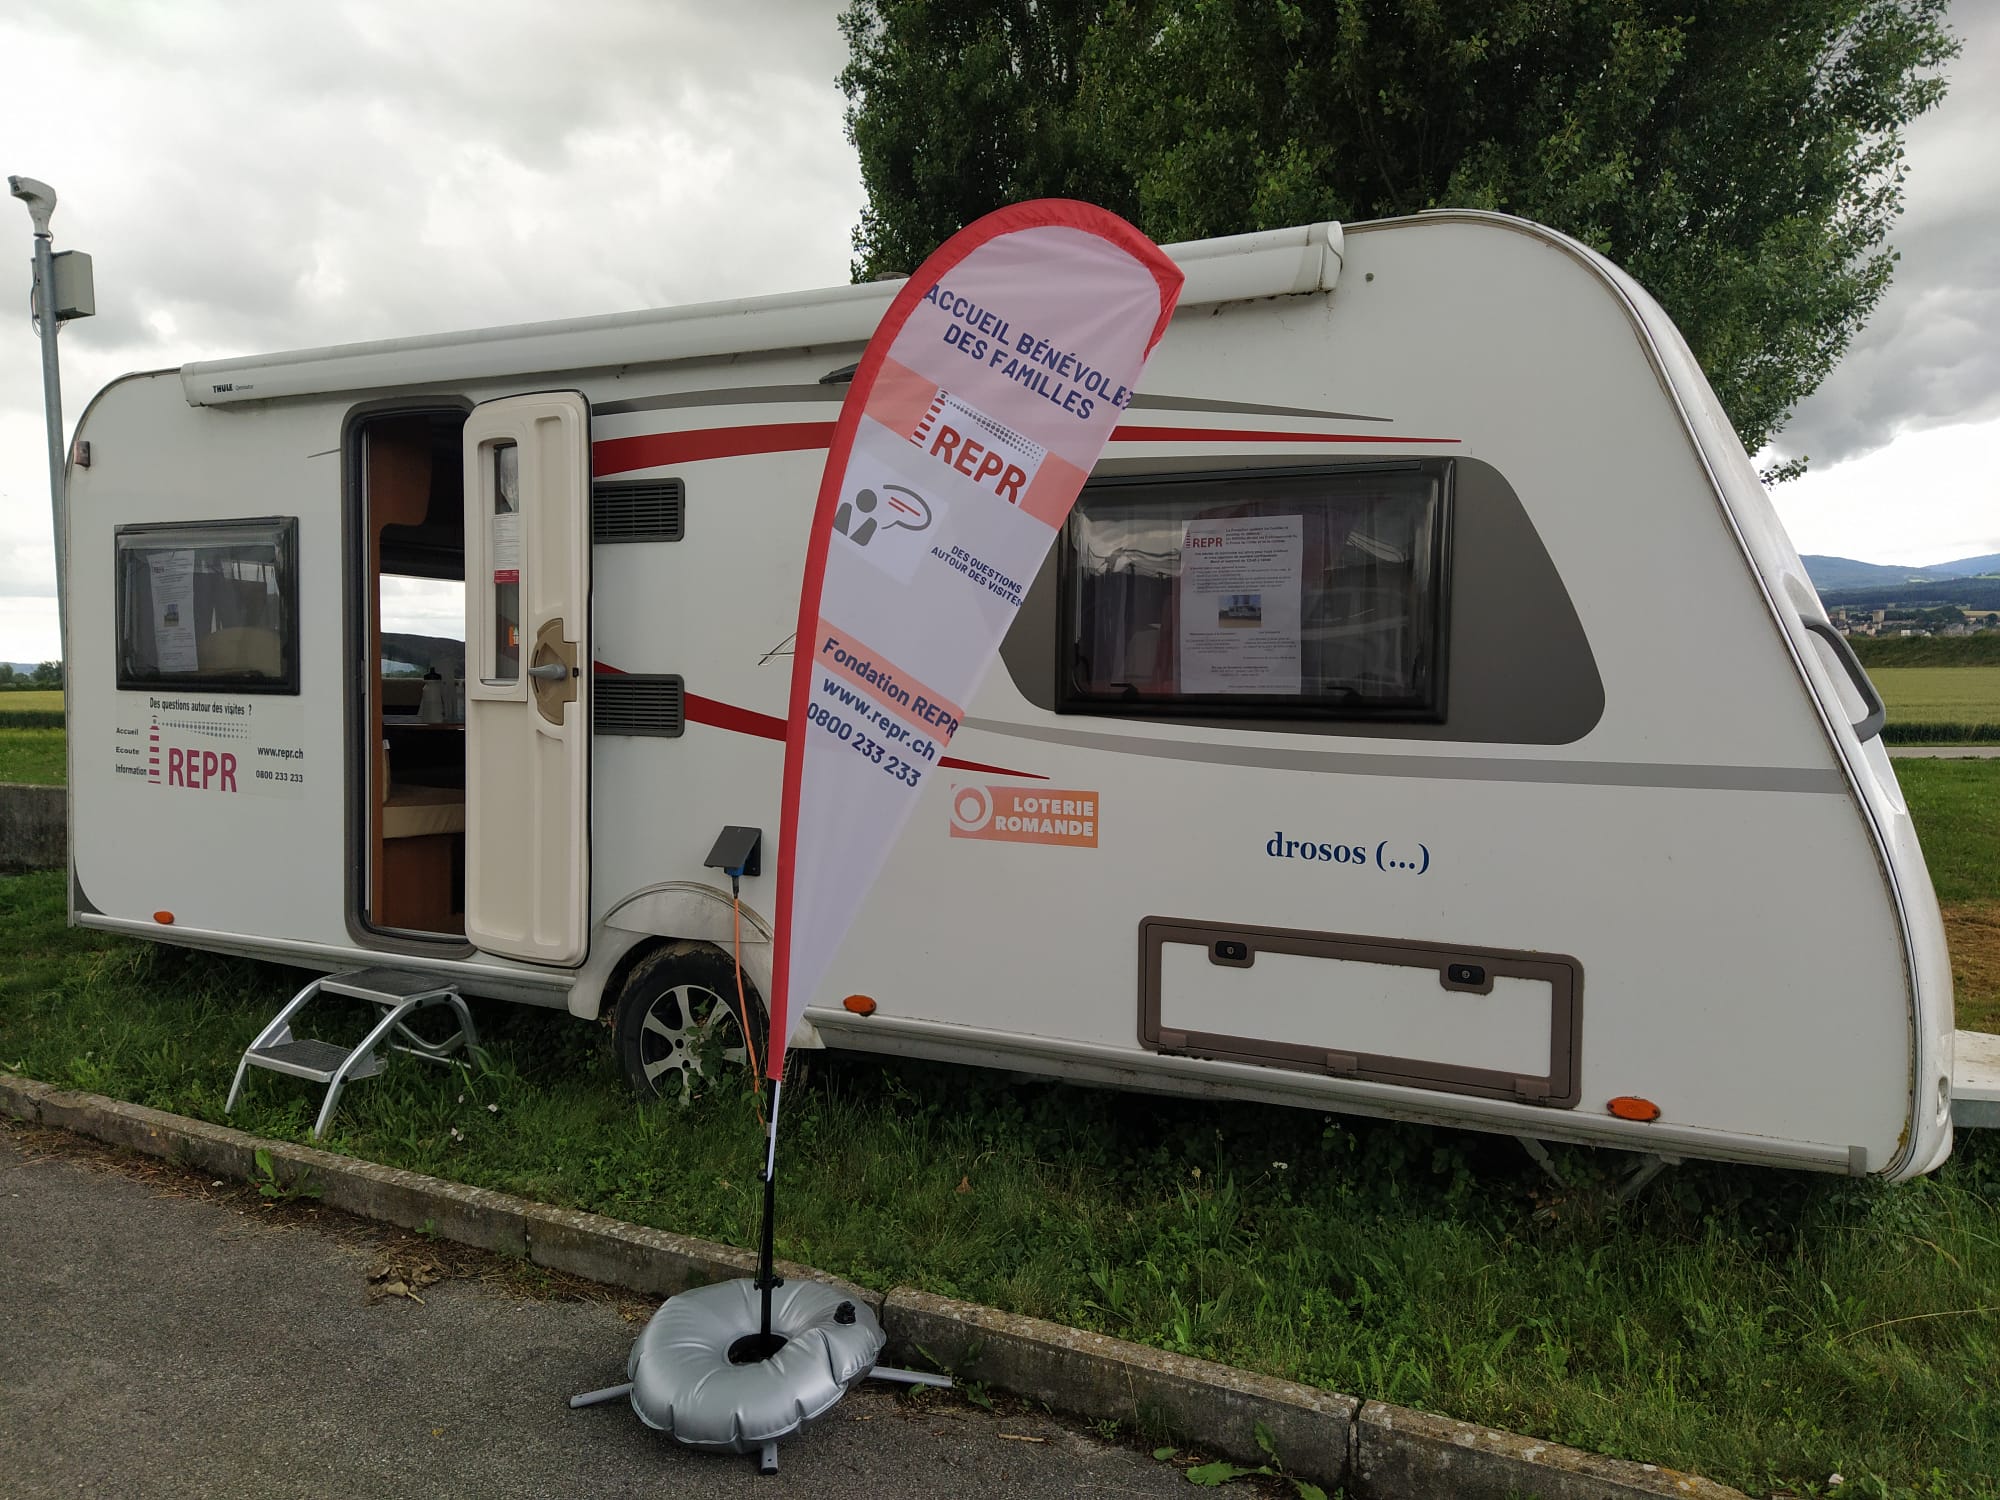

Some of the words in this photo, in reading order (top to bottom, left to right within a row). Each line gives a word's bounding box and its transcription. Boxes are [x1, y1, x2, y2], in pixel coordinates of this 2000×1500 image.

[923, 284, 1009, 345] ACCUEIL
[943, 323, 988, 359] DES
[989, 349, 1095, 419] FAMILLES
[213, 383, 233, 393] THULE
[929, 425, 1027, 504] REPR
[1192, 537, 1223, 548] REPR
[931, 547, 968, 573] AUTOUR
[968, 569, 987, 585] DES
[988, 581, 1023, 607] VISITES
[951, 546, 970, 562] DES
[970, 558, 1022, 594] QUESTIONS
[822, 637, 910, 706] Fondation
[911, 695, 959, 738] REPR
[149, 697, 161, 709] Des
[162, 699, 190, 712] questions
[191, 702, 211, 713] autour
[212, 702, 223, 713] des
[224, 703, 245, 715] visites
[823, 678, 936, 761] www.repr.ch
[115, 727, 139, 736] Accueil
[807, 702, 853, 741] 0800
[852, 732, 886, 764] 233
[884, 756, 922, 787] 233
[115, 746, 140, 755] Ecoute
[257, 746, 304, 760] www.repr.ch
[115, 764, 147, 776] Information
[168, 747, 237, 792] REPR
[255, 770, 273, 780] 0800
[275, 771, 288, 781] 233
[290, 773, 303, 783] 233
[1013, 797, 1095, 817] LOTERIE
[995, 815, 1095, 838] ROMANDE
[1266, 831, 1366, 865] drosos
